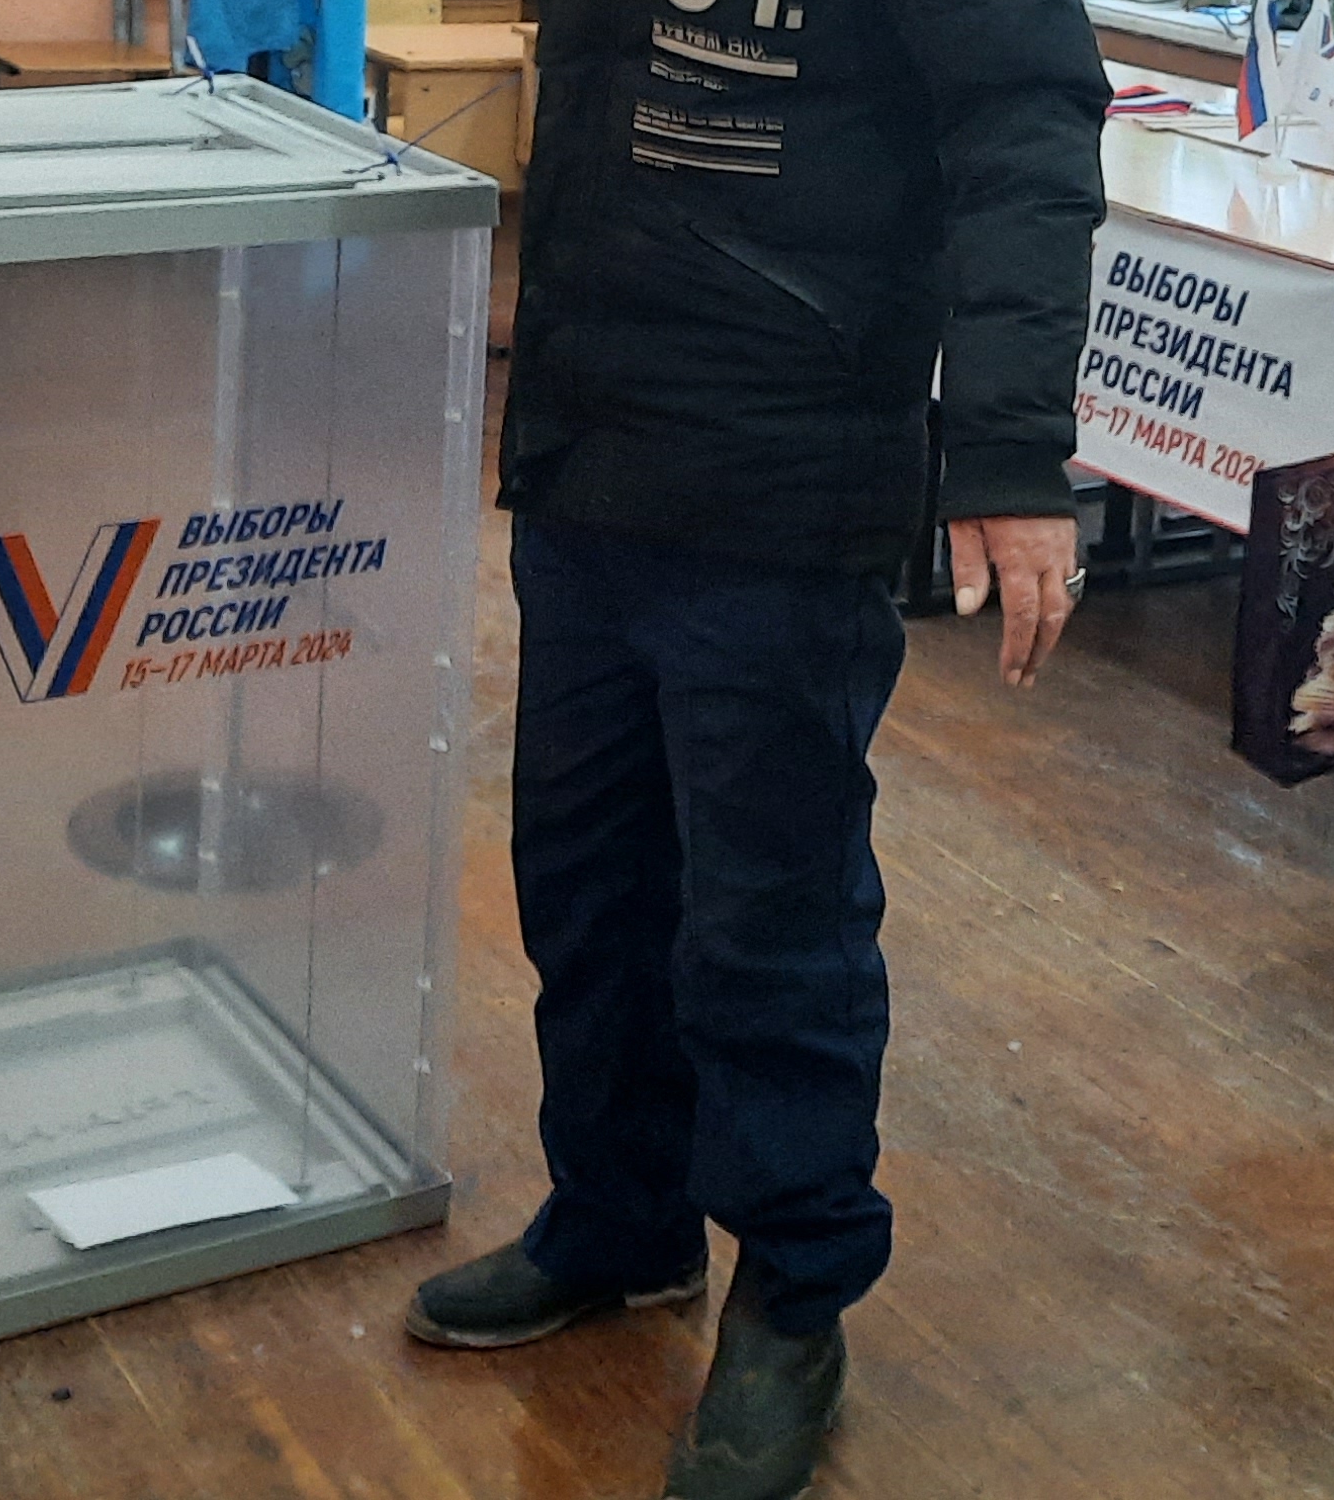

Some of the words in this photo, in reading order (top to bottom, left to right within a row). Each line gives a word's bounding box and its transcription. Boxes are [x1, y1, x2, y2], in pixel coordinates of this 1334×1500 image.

[1107, 251, 1250, 327] ВЫБОРЫ
[1094, 299, 1294, 398] ПРЕЗИДЕНТА
[1082, 347, 1205, 420] РОССИИ
[1130, 414, 1208, 469] МАРТА
[178, 499, 344, 549] ВЫБОРЫ
[155, 537, 388, 599] ПРЕЗИДЕНТА
[136, 596, 291, 647] РОССИИ
[197, 638, 289, 679] МАРТА
[289, 630, 354, 665] 2024
